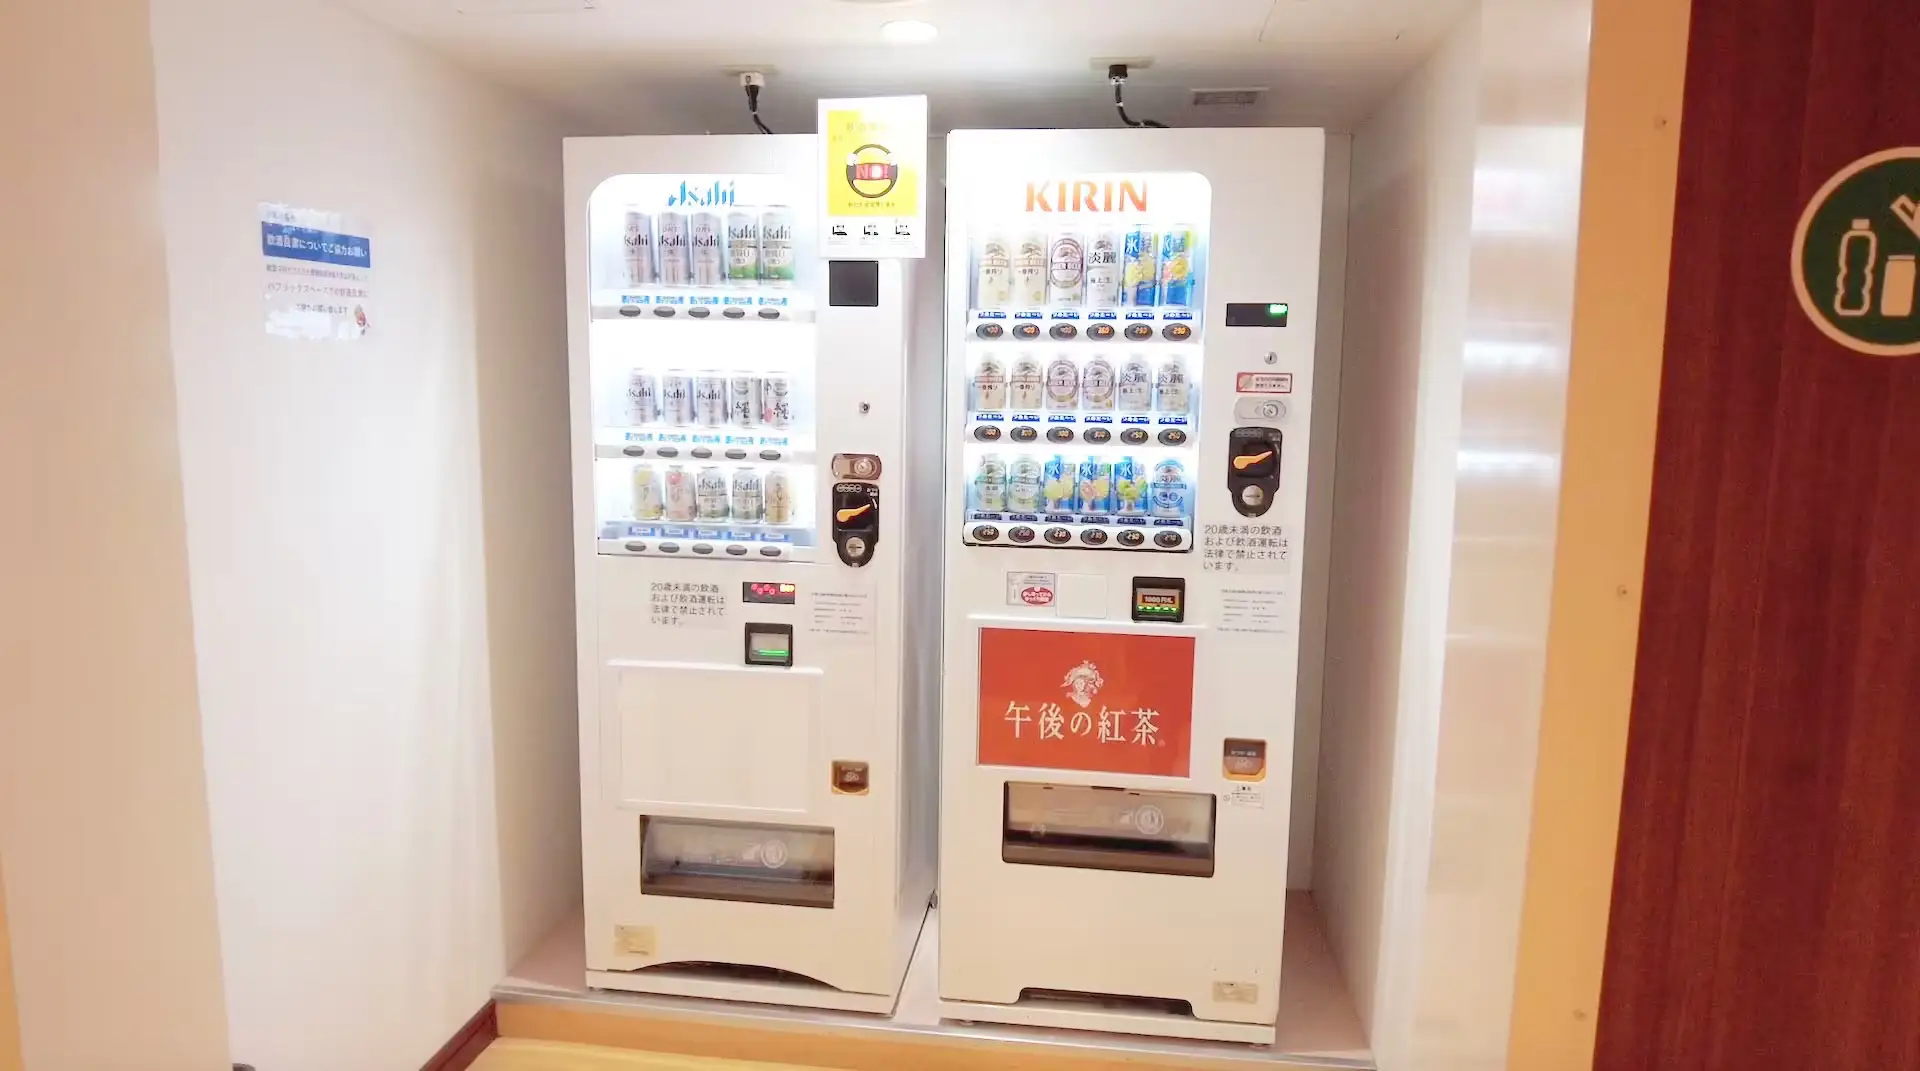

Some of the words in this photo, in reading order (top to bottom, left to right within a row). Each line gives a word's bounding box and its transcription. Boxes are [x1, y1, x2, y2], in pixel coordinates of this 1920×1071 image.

[668, 180, 735, 206] Asahi
[1024, 180, 1148, 212] KIRIN
[1088, 251, 1117, 264] 淡麗
[1203, 524, 1282, 535] 20歳未満の飲酒
[1204, 536, 1289, 548] および飲酒運転は
[1203, 549, 1289, 560] 法律で禁止されて
[1202, 561, 1240, 572] います。
[651, 582, 719, 593] 20歳未満の飲酒
[651, 594, 725, 605] および飲酒運転は
[651, 605, 725, 616] 法律で禁止されて
[651, 616, 685, 626] います。
[1004, 700, 1160, 746] 午後の紅茶
